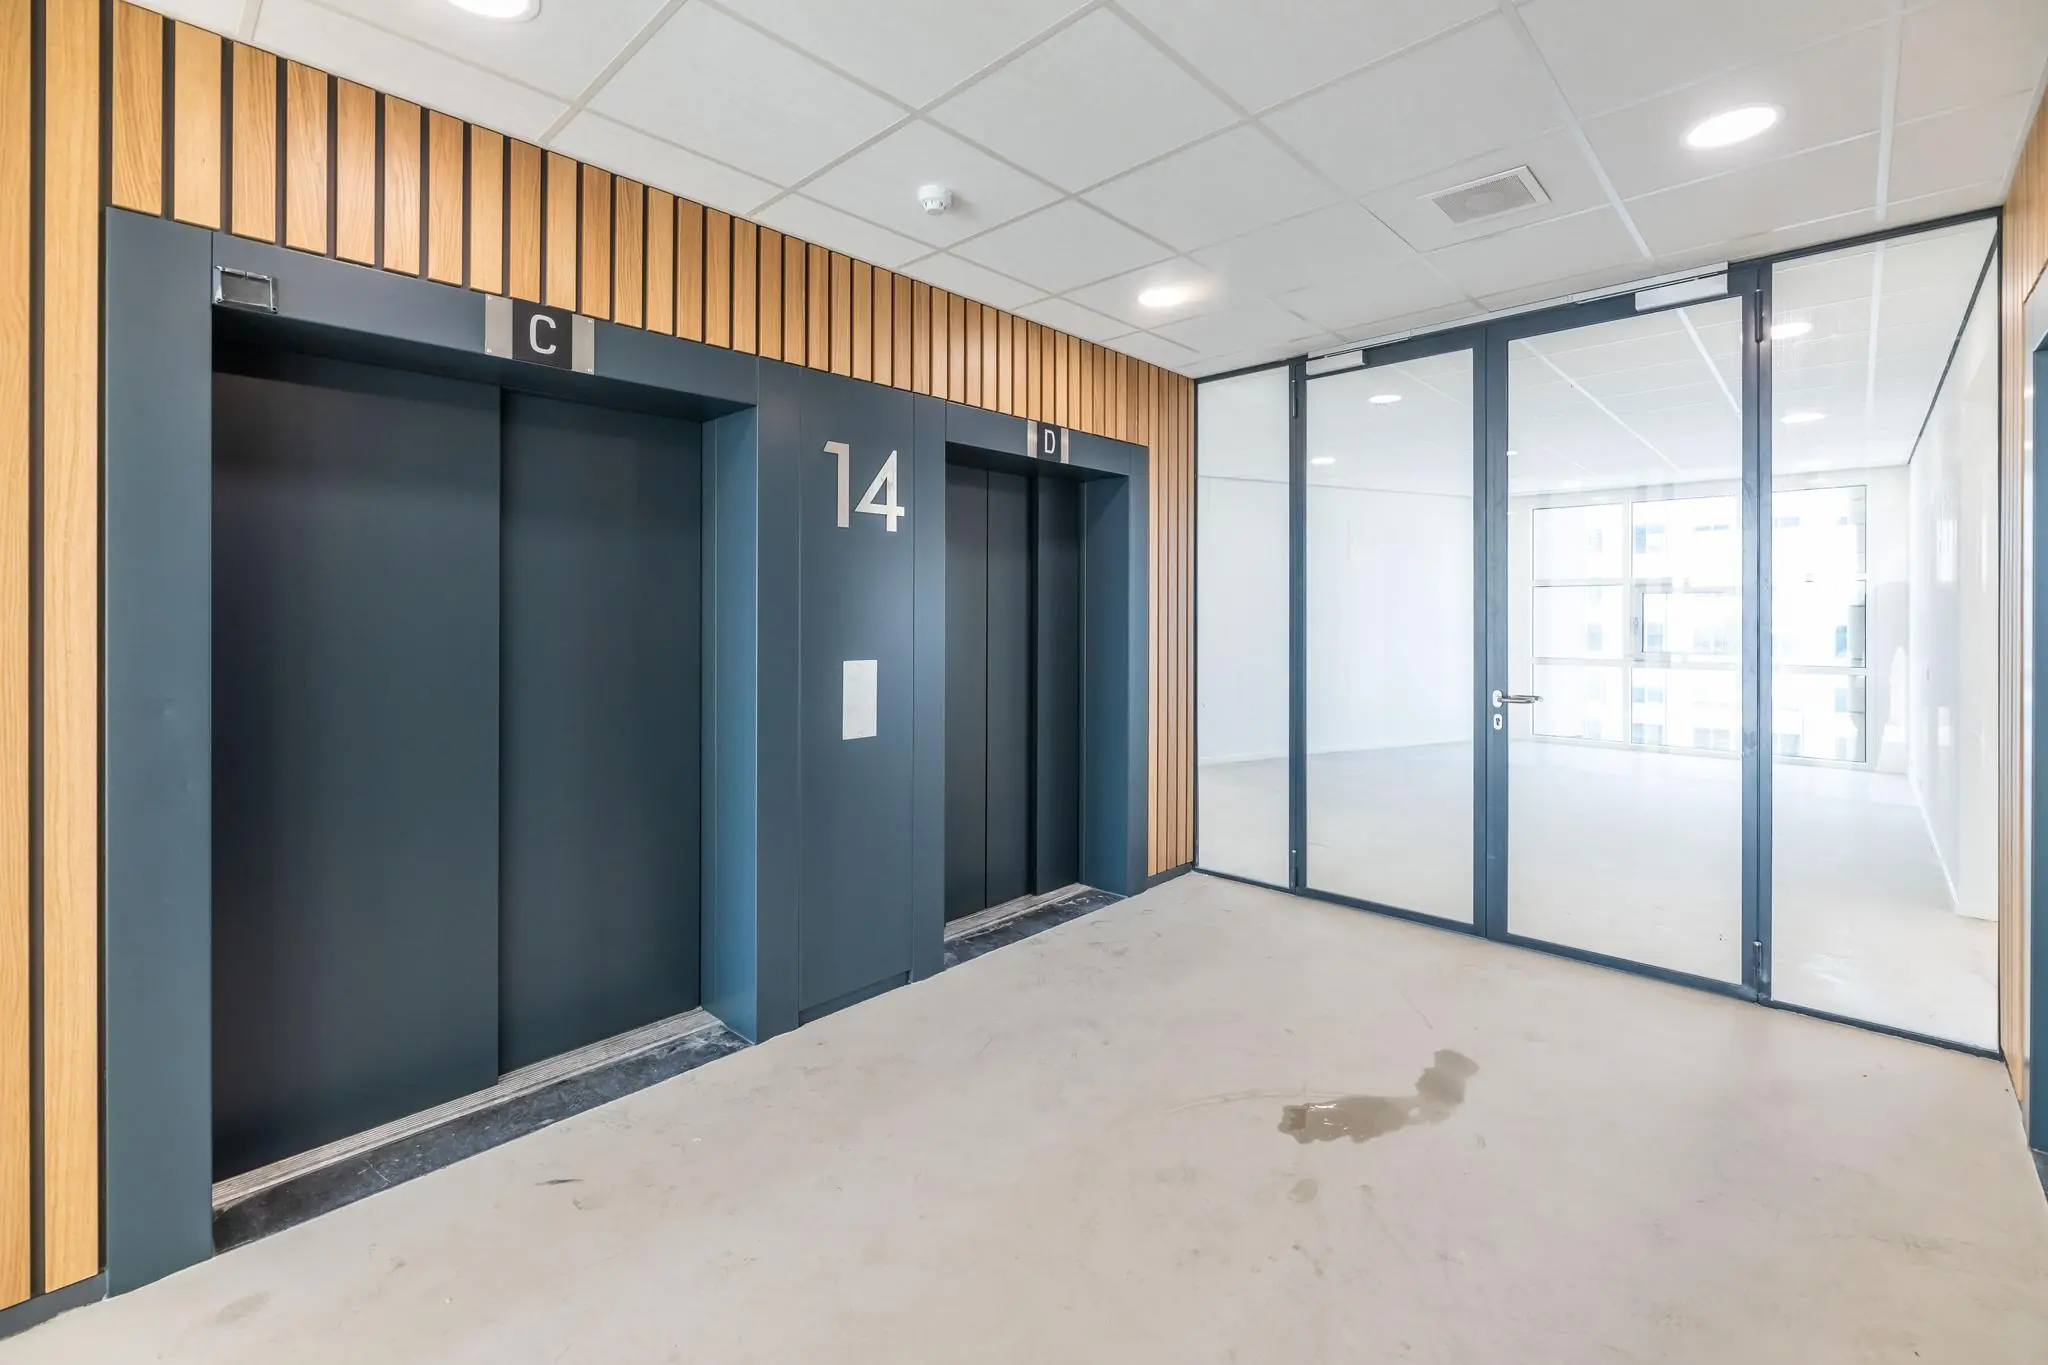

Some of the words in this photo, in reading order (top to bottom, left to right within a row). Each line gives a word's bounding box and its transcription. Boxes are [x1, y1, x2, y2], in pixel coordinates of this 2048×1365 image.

[530, 314, 557, 355] C
[1044, 428, 1056, 454] D
[823, 440, 905, 532] 14
